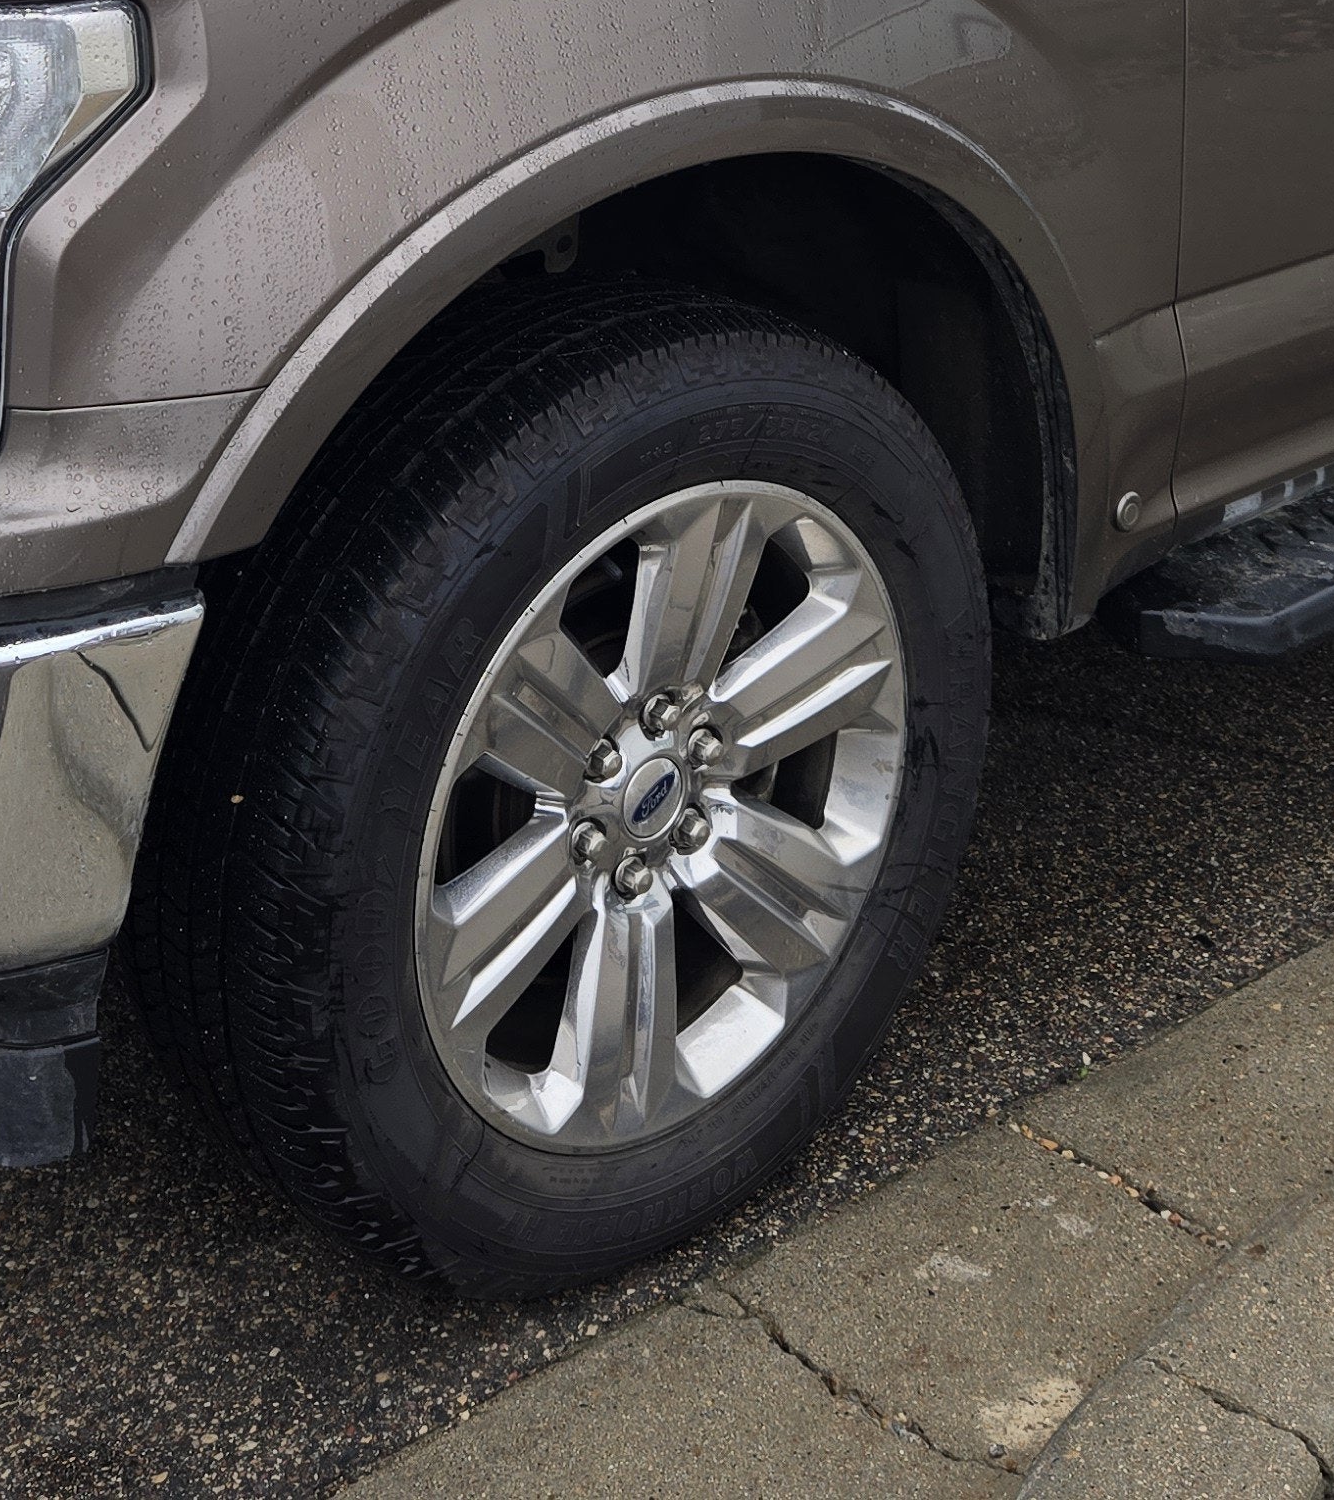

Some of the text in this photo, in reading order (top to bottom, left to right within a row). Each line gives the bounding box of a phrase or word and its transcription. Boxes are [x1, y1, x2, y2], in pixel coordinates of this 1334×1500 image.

[641, 780, 668, 818] Ford
[353, 615, 486, 1085] GOODYEAR
[550, 1147, 759, 1248] WORKHORSE
